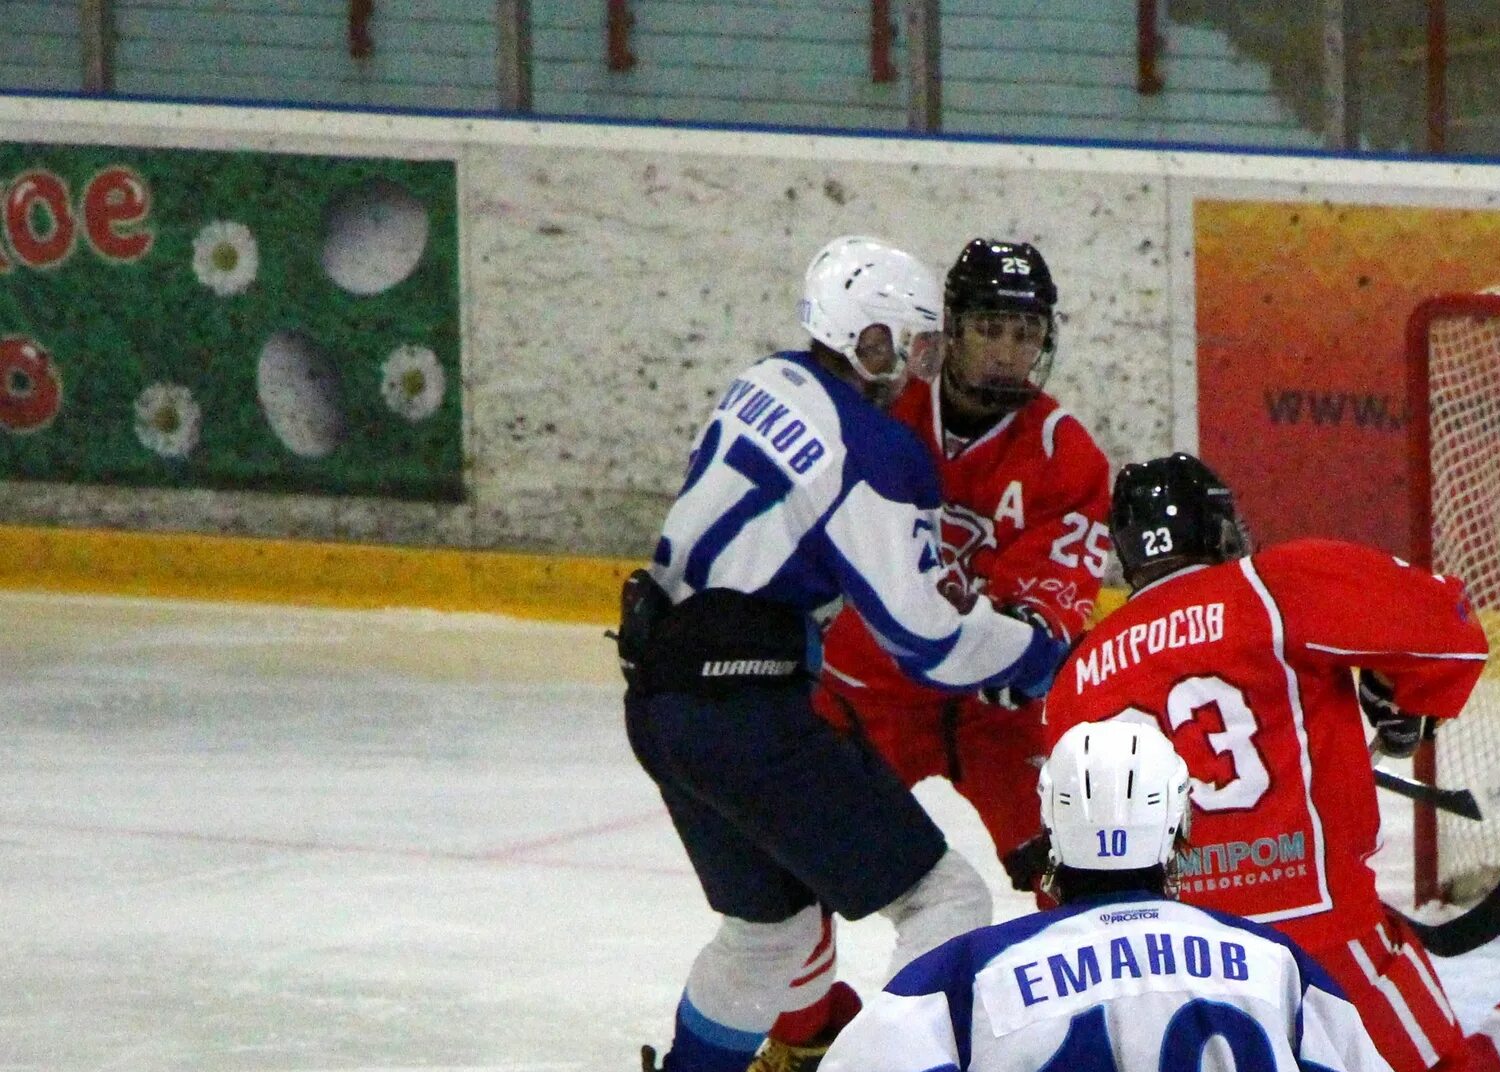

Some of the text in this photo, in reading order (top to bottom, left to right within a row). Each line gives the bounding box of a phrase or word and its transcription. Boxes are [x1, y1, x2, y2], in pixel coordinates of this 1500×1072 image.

[0, 164, 155, 272] ое
[1002, 257, 1031, 275] 25
[994, 480, 1025, 529] A
[1050, 511, 1110, 579] 25
[1142, 527, 1173, 557] 23
[1076, 602, 1225, 695] МАТРОСОВ
[1096, 829, 1127, 857] 10
[1110, 911, 1159, 923] PROSTOR
[1013, 933, 1249, 1007] ЕМАНОВ
